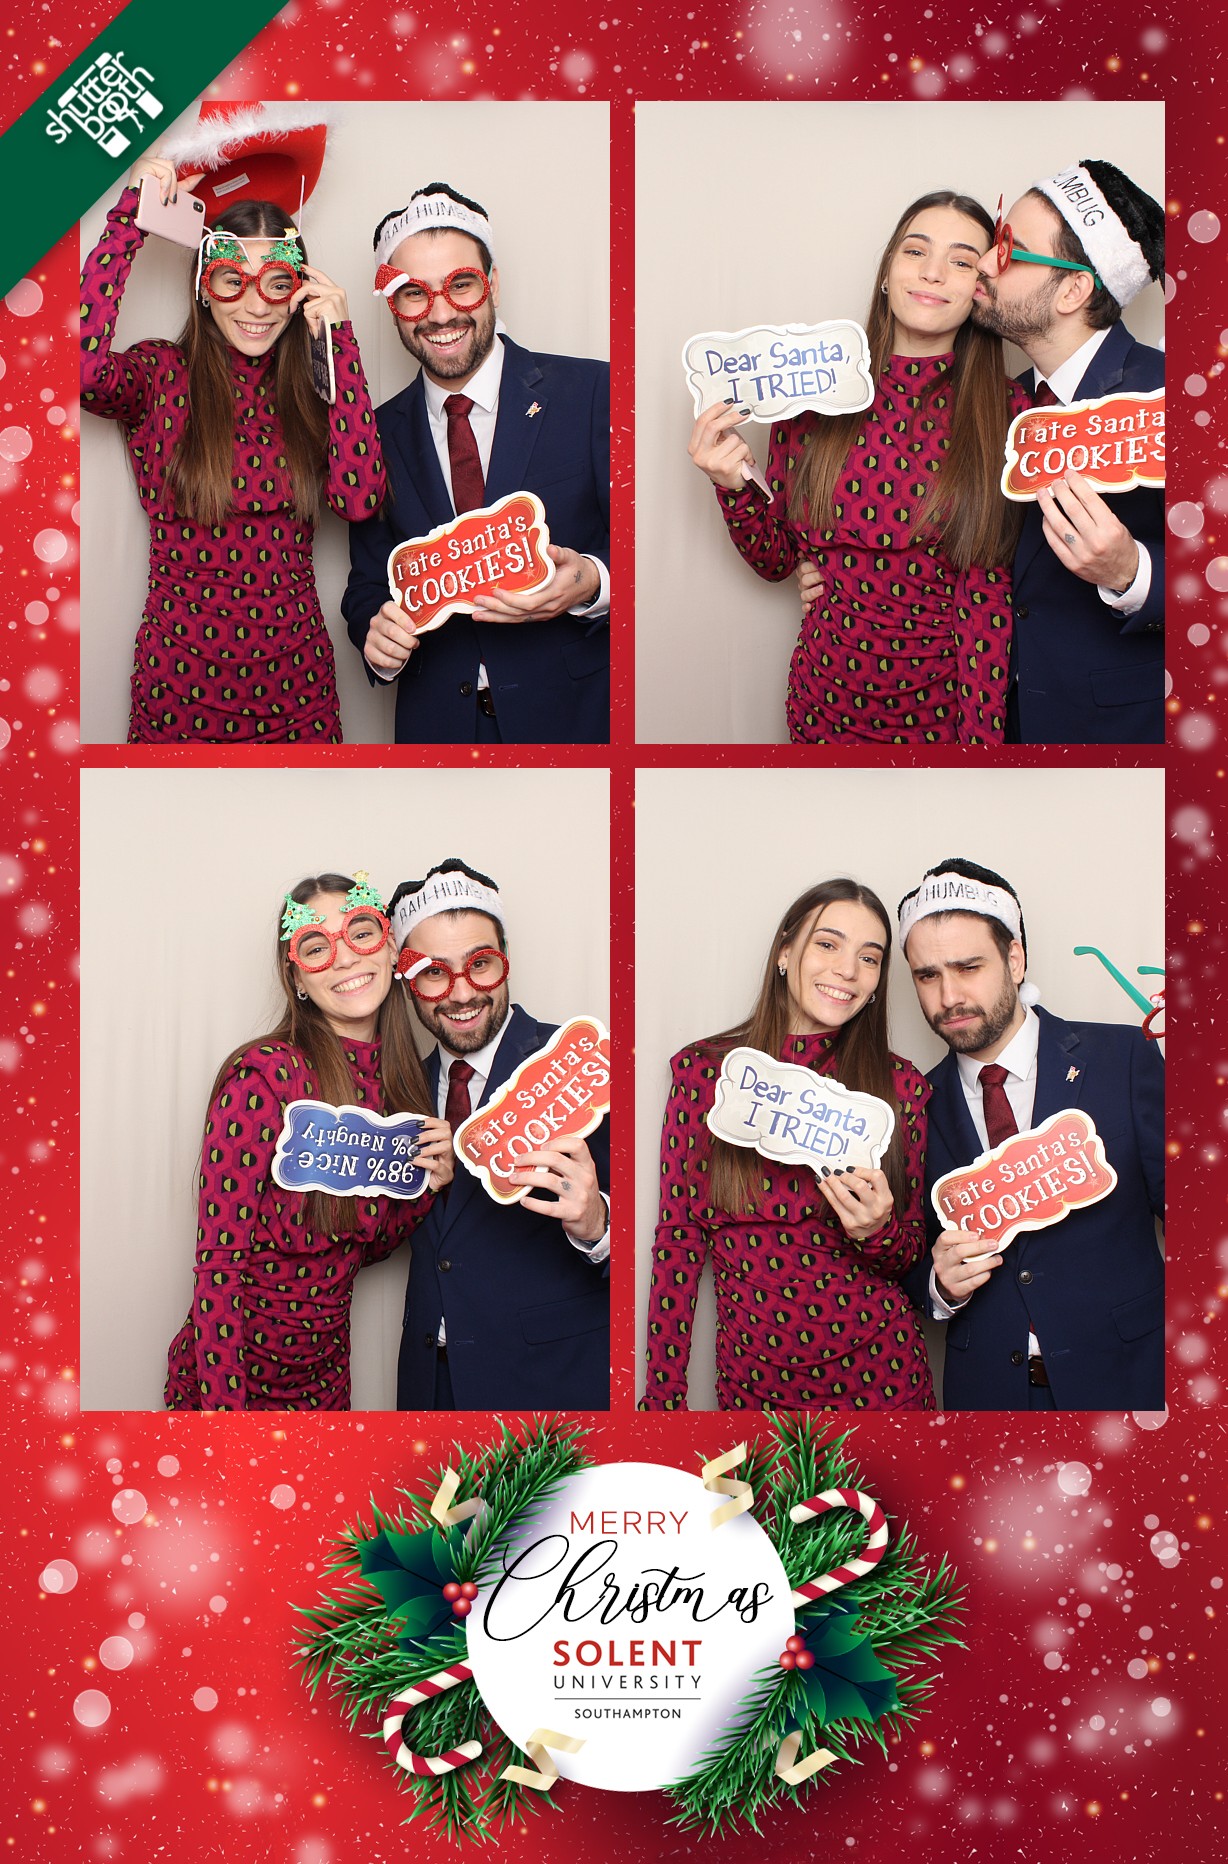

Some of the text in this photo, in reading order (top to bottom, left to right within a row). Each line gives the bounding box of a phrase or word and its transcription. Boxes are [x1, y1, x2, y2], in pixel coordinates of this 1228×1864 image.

[705, 341, 850, 376] Dear Santa,
[728, 368, 837, 404] I TRIED!
[1019, 428, 1027, 444] I
[1035, 421, 1077, 443] ate
[396, 516, 528, 581] I ate Santa's
[404, 536, 535, 612] COOKIES!
[467, 1036, 595, 1158] I ate Santa's
[740, 1065, 870, 1142] Dear Santa,
[301, 1121, 387, 1152] Naughty
[743, 1101, 850, 1162] I TRIED!
[298, 1151, 416, 1184] 98% Nice
[942, 1131, 1083, 1214] I ate Santa's
